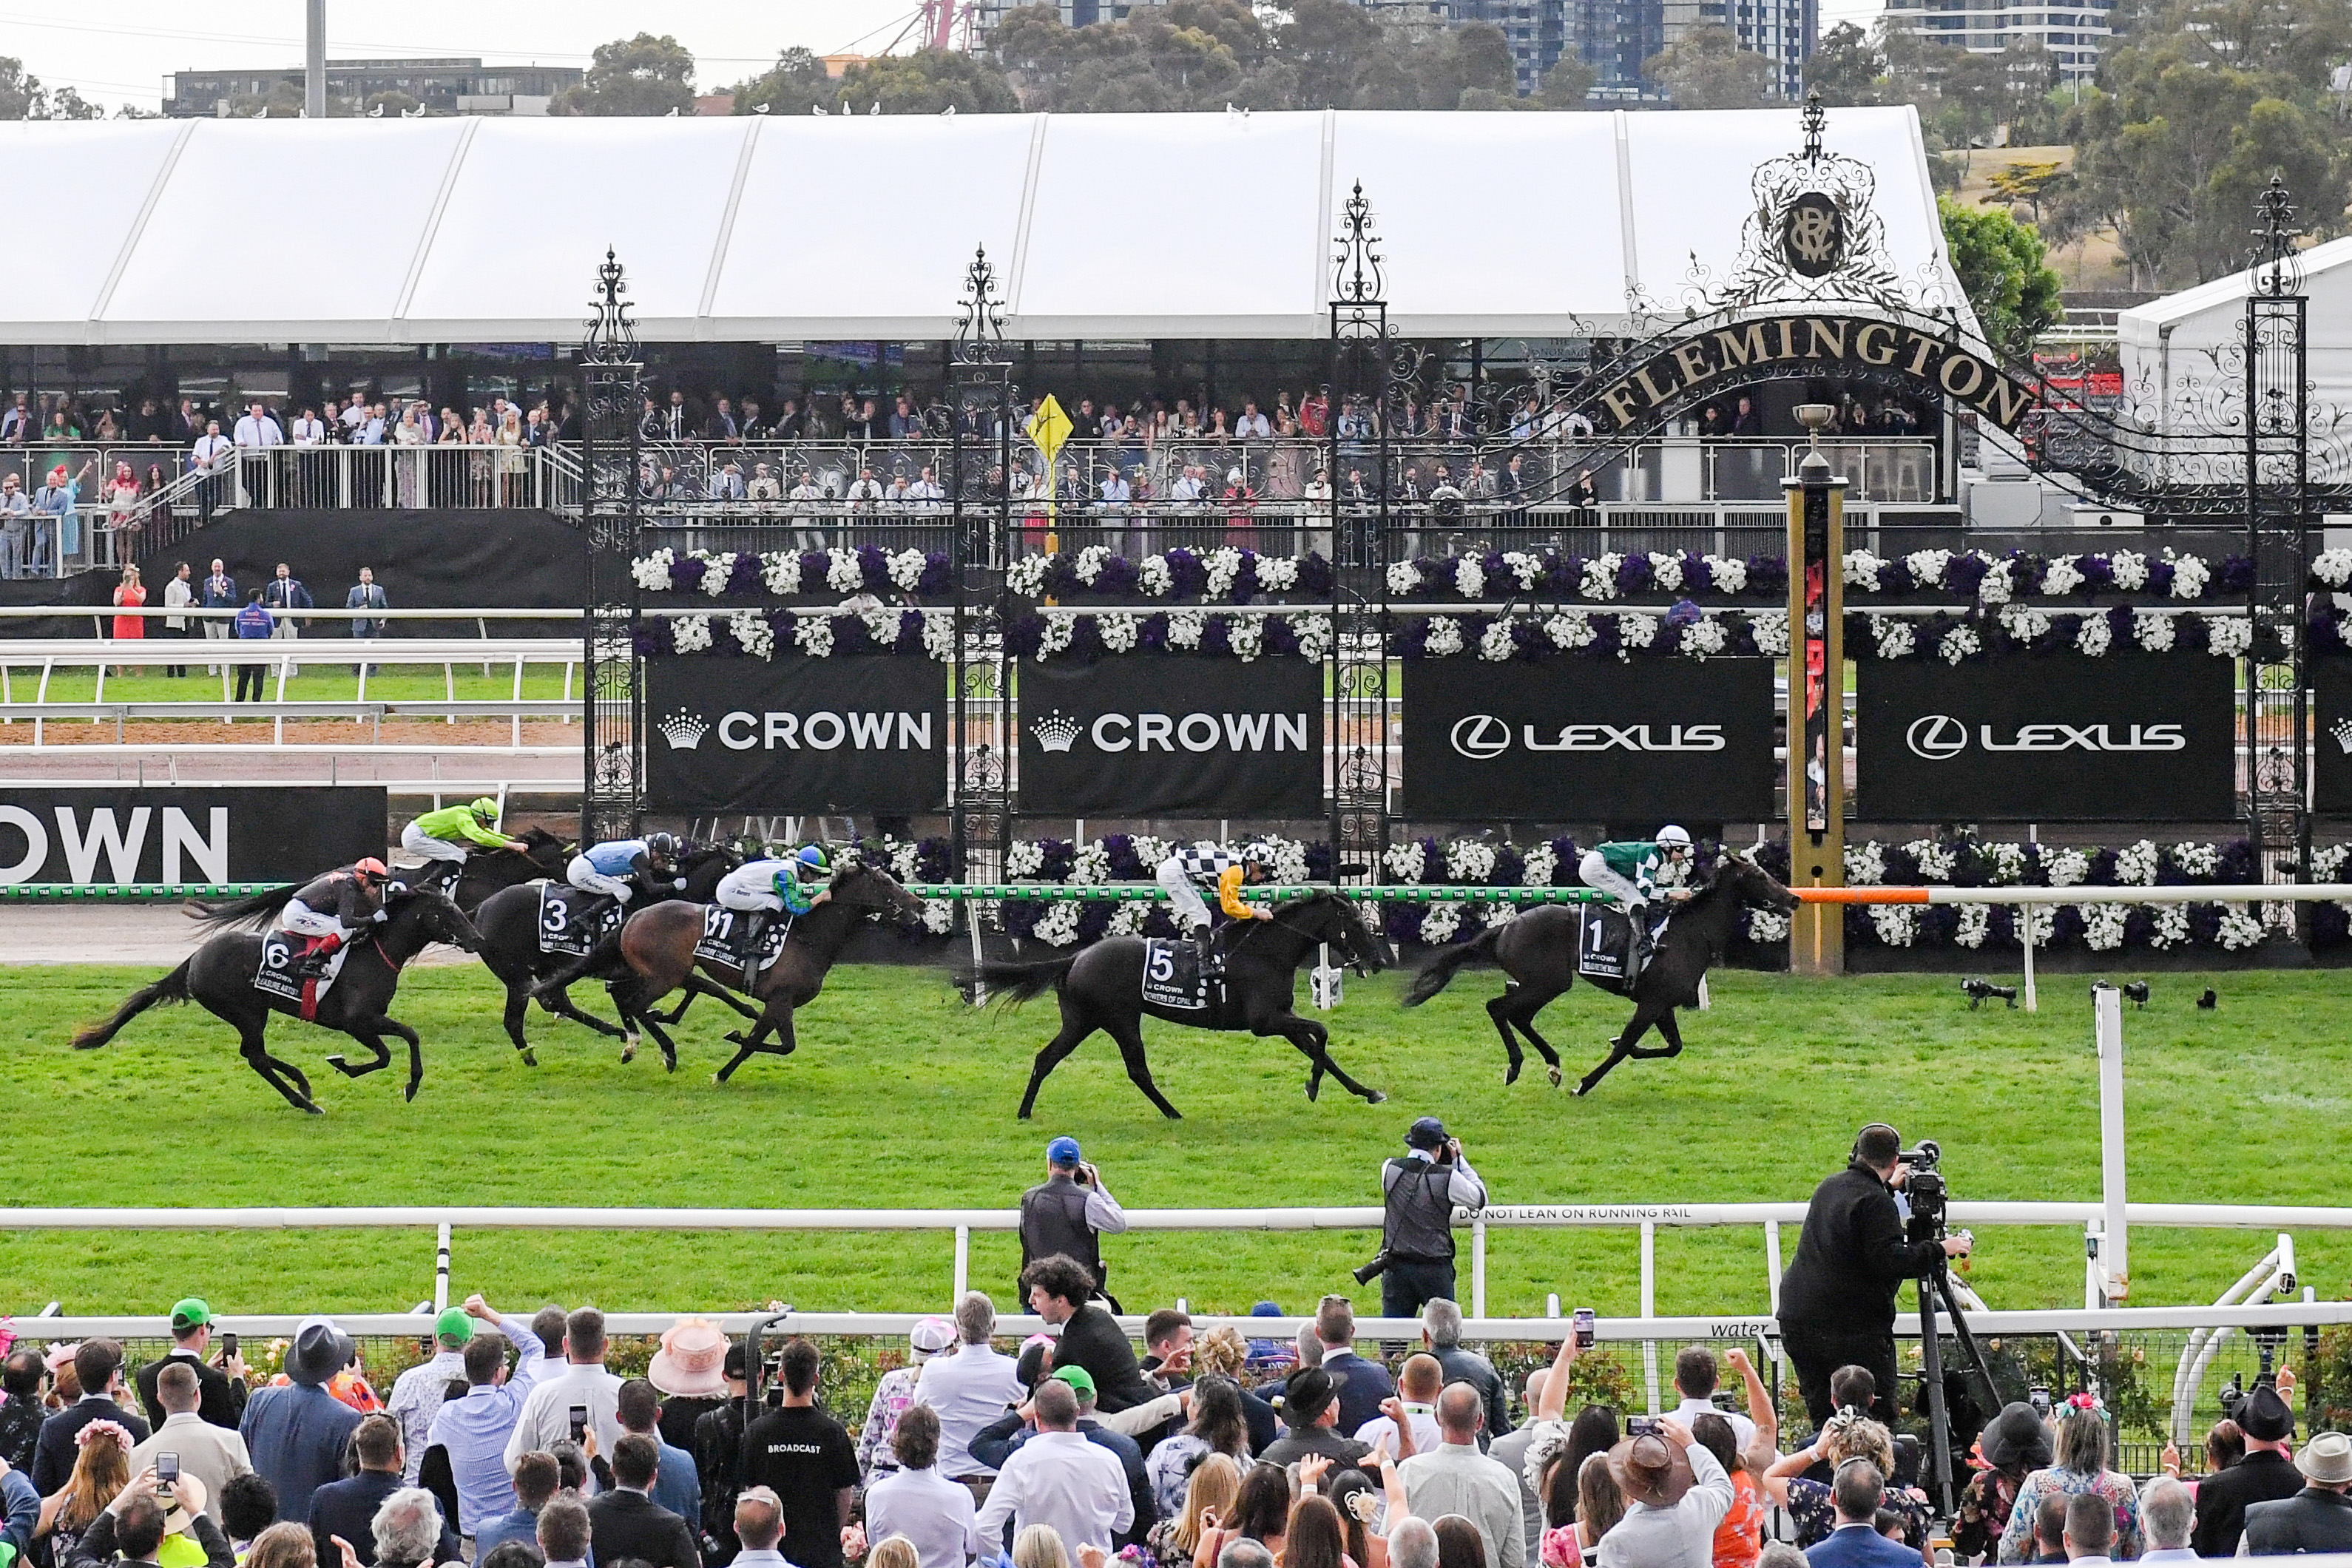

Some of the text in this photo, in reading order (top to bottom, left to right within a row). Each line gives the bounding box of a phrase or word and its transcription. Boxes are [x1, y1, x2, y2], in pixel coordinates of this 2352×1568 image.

[1599, 318, 2032, 431] FLEMINGTON
[717, 711, 932, 751] CROWN
[1092, 712, 1308, 753] CROWN
[1524, 724, 1726, 751] LEXUS
[1981, 723, 2186, 751] LEXUS
[544, 899, 567, 931] 3
[708, 910, 734, 939] 11
[1589, 919, 1602, 952] 1
[267, 943, 289, 969] 6
[1150, 947, 1174, 981] 5
[266, 970, 293, 984] CROWN
[1154, 984, 1183, 994] CROWN
[1459, 1208, 1692, 1220] DO NOT LEAN ON RUNNING RAIL
[1711, 1321, 1769, 1337] water
[768, 1444, 821, 1455] BROADCAST
